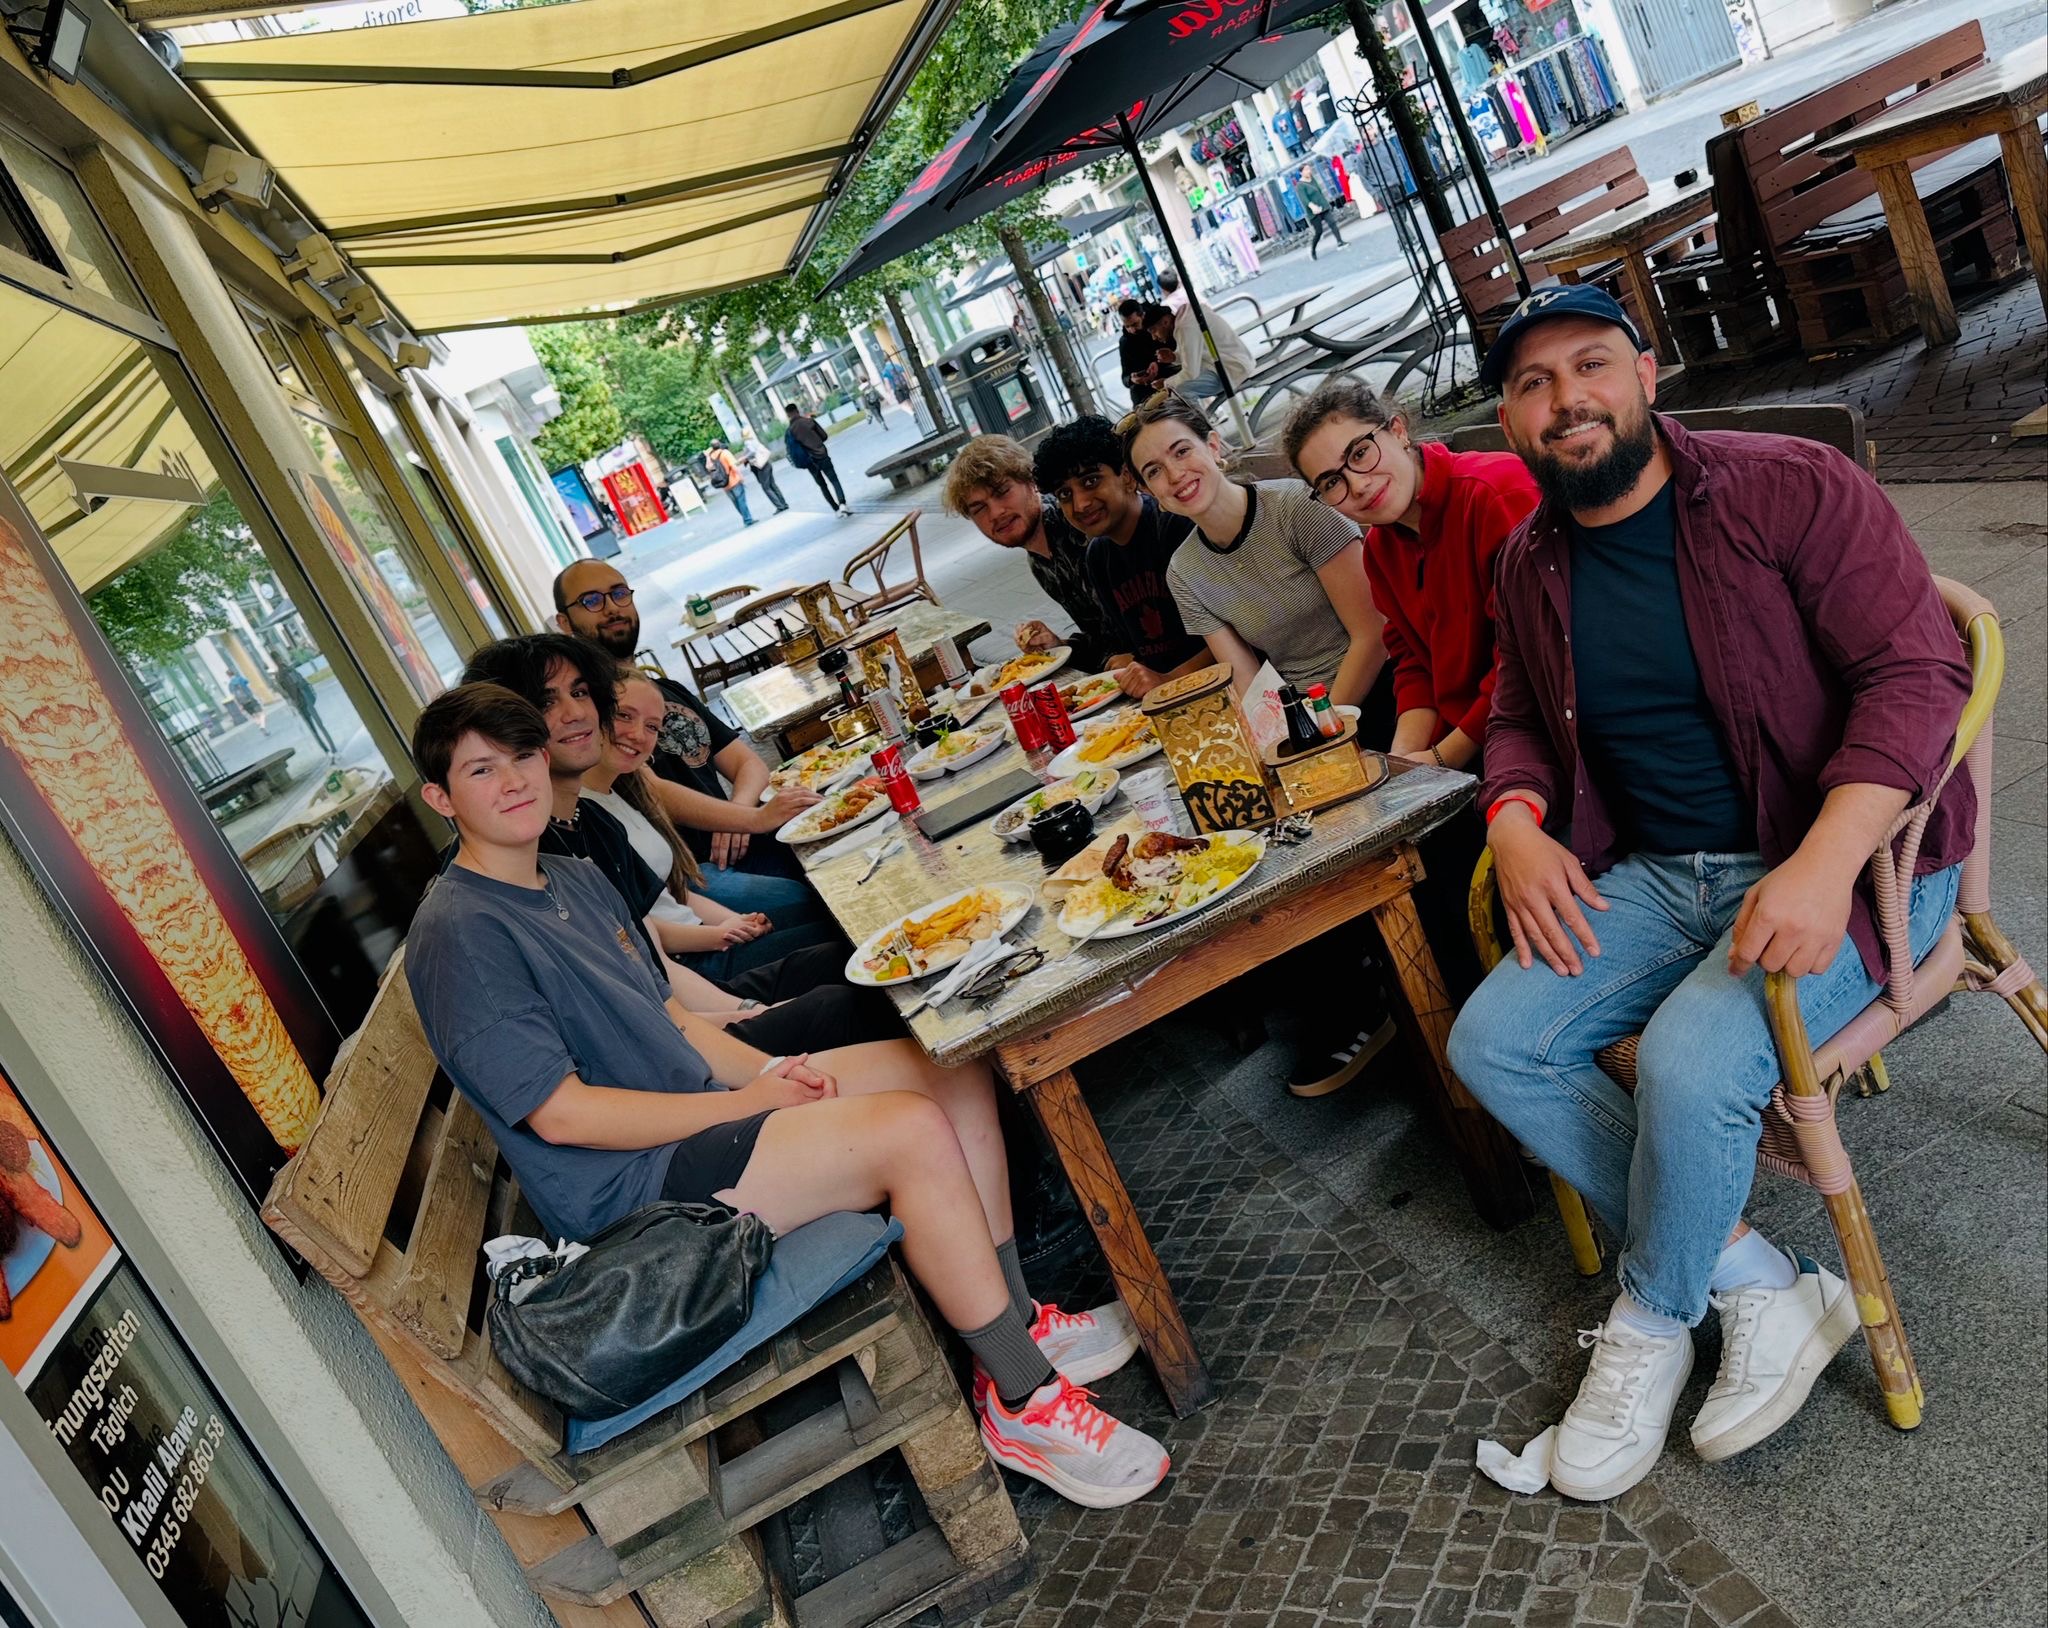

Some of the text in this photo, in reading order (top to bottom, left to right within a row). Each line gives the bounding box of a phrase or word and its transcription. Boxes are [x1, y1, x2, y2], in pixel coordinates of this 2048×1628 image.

[90, 1383, 139, 1455] Täglich
[121, 1405, 199, 1546] Khalil Alawe
[146, 1414, 225, 1579] 0345 682 860 58
